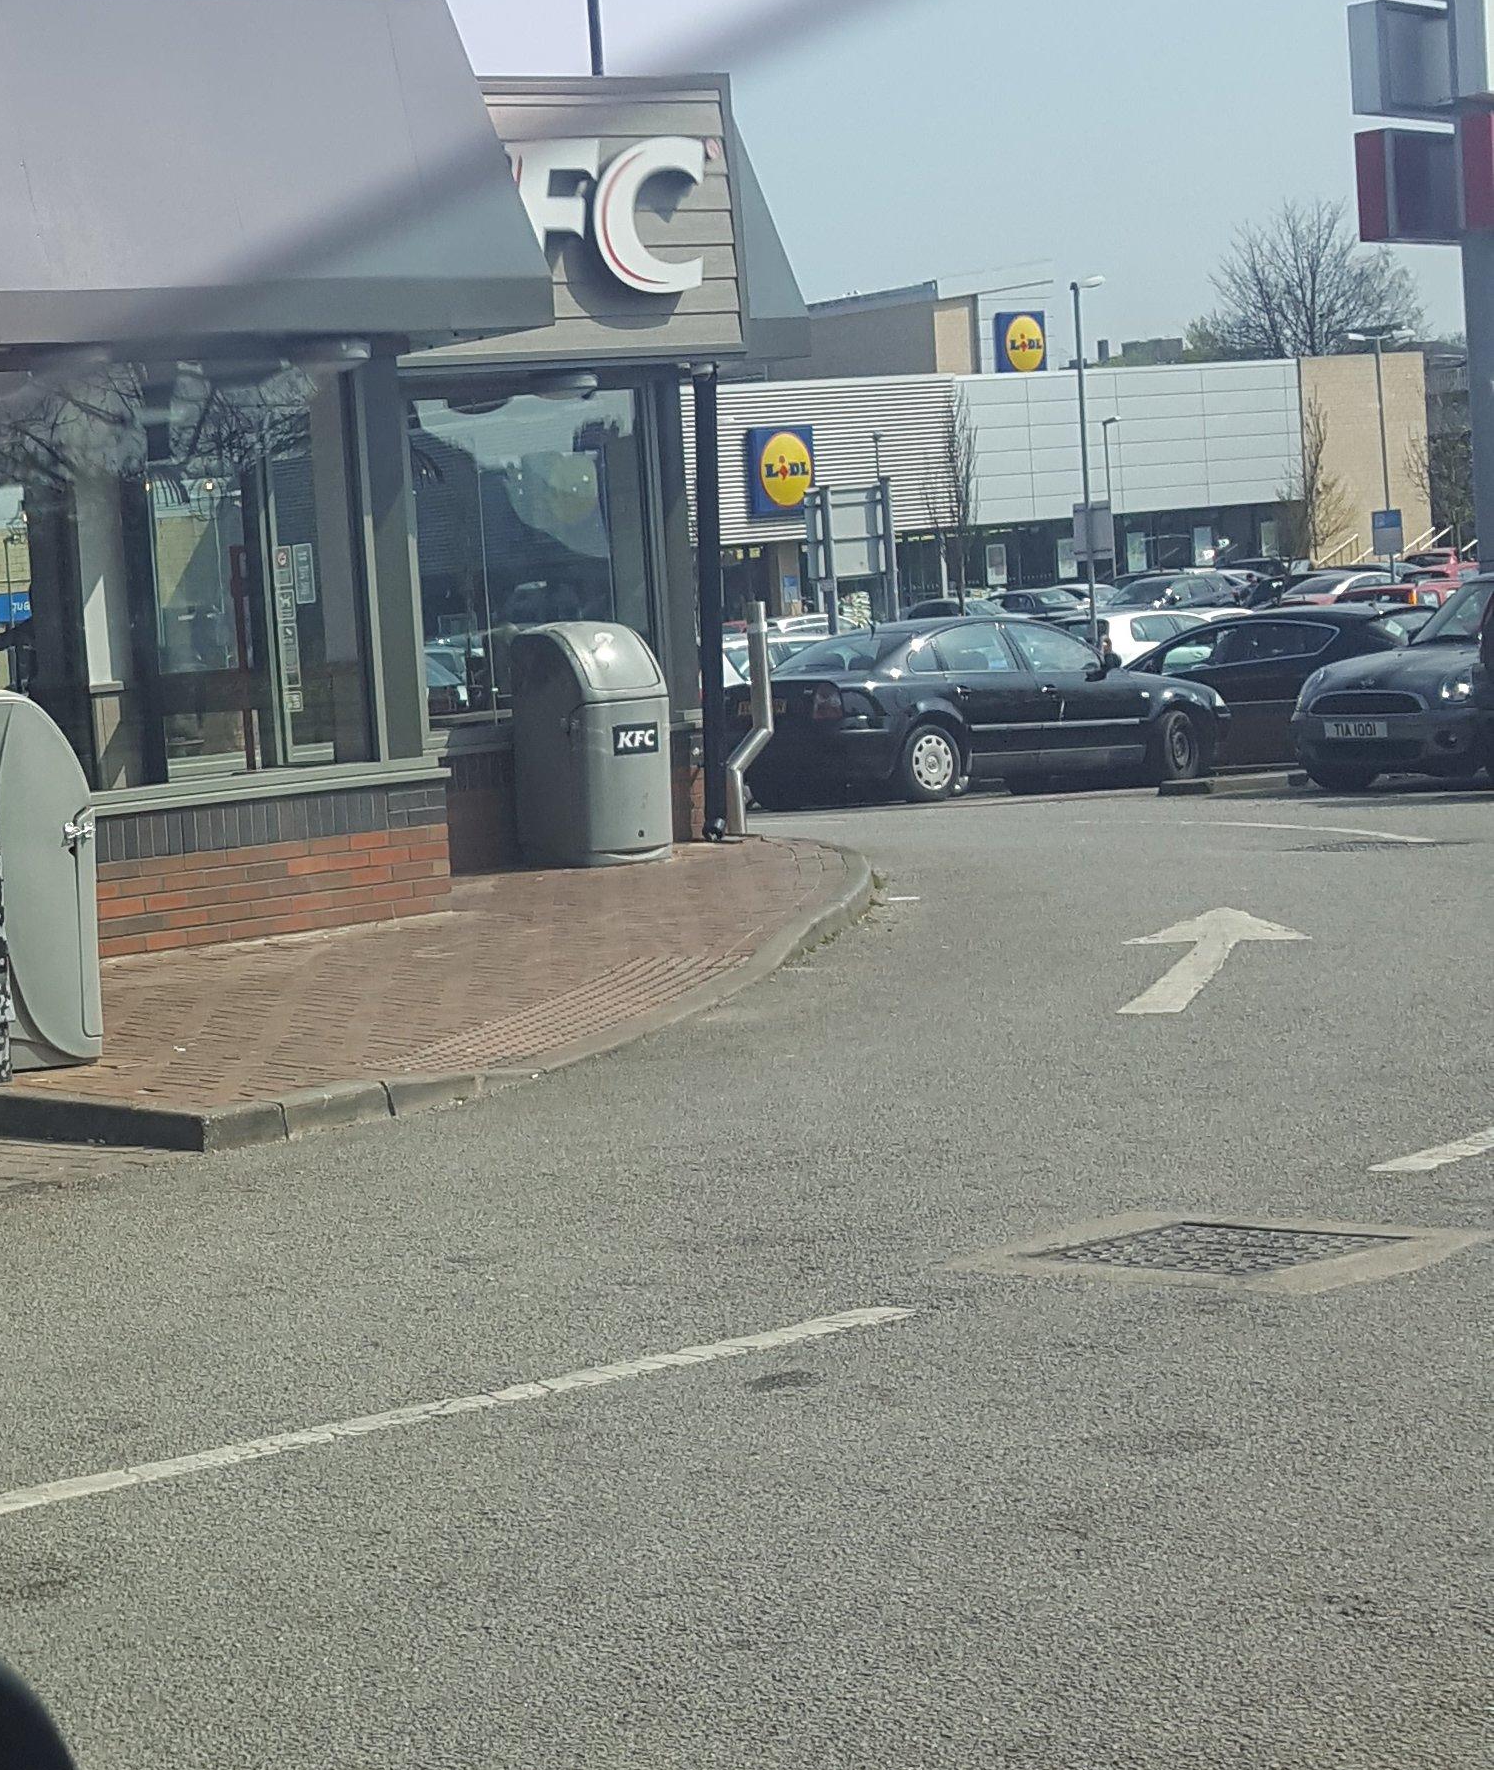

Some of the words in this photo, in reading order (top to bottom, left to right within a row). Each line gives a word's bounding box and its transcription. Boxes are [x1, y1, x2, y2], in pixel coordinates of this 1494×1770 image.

[505, 136, 704, 293] FC
[1010, 333, 1043, 352] LIDL
[765, 455, 810, 481] LIDL
[616, 729, 655, 748] KFC
